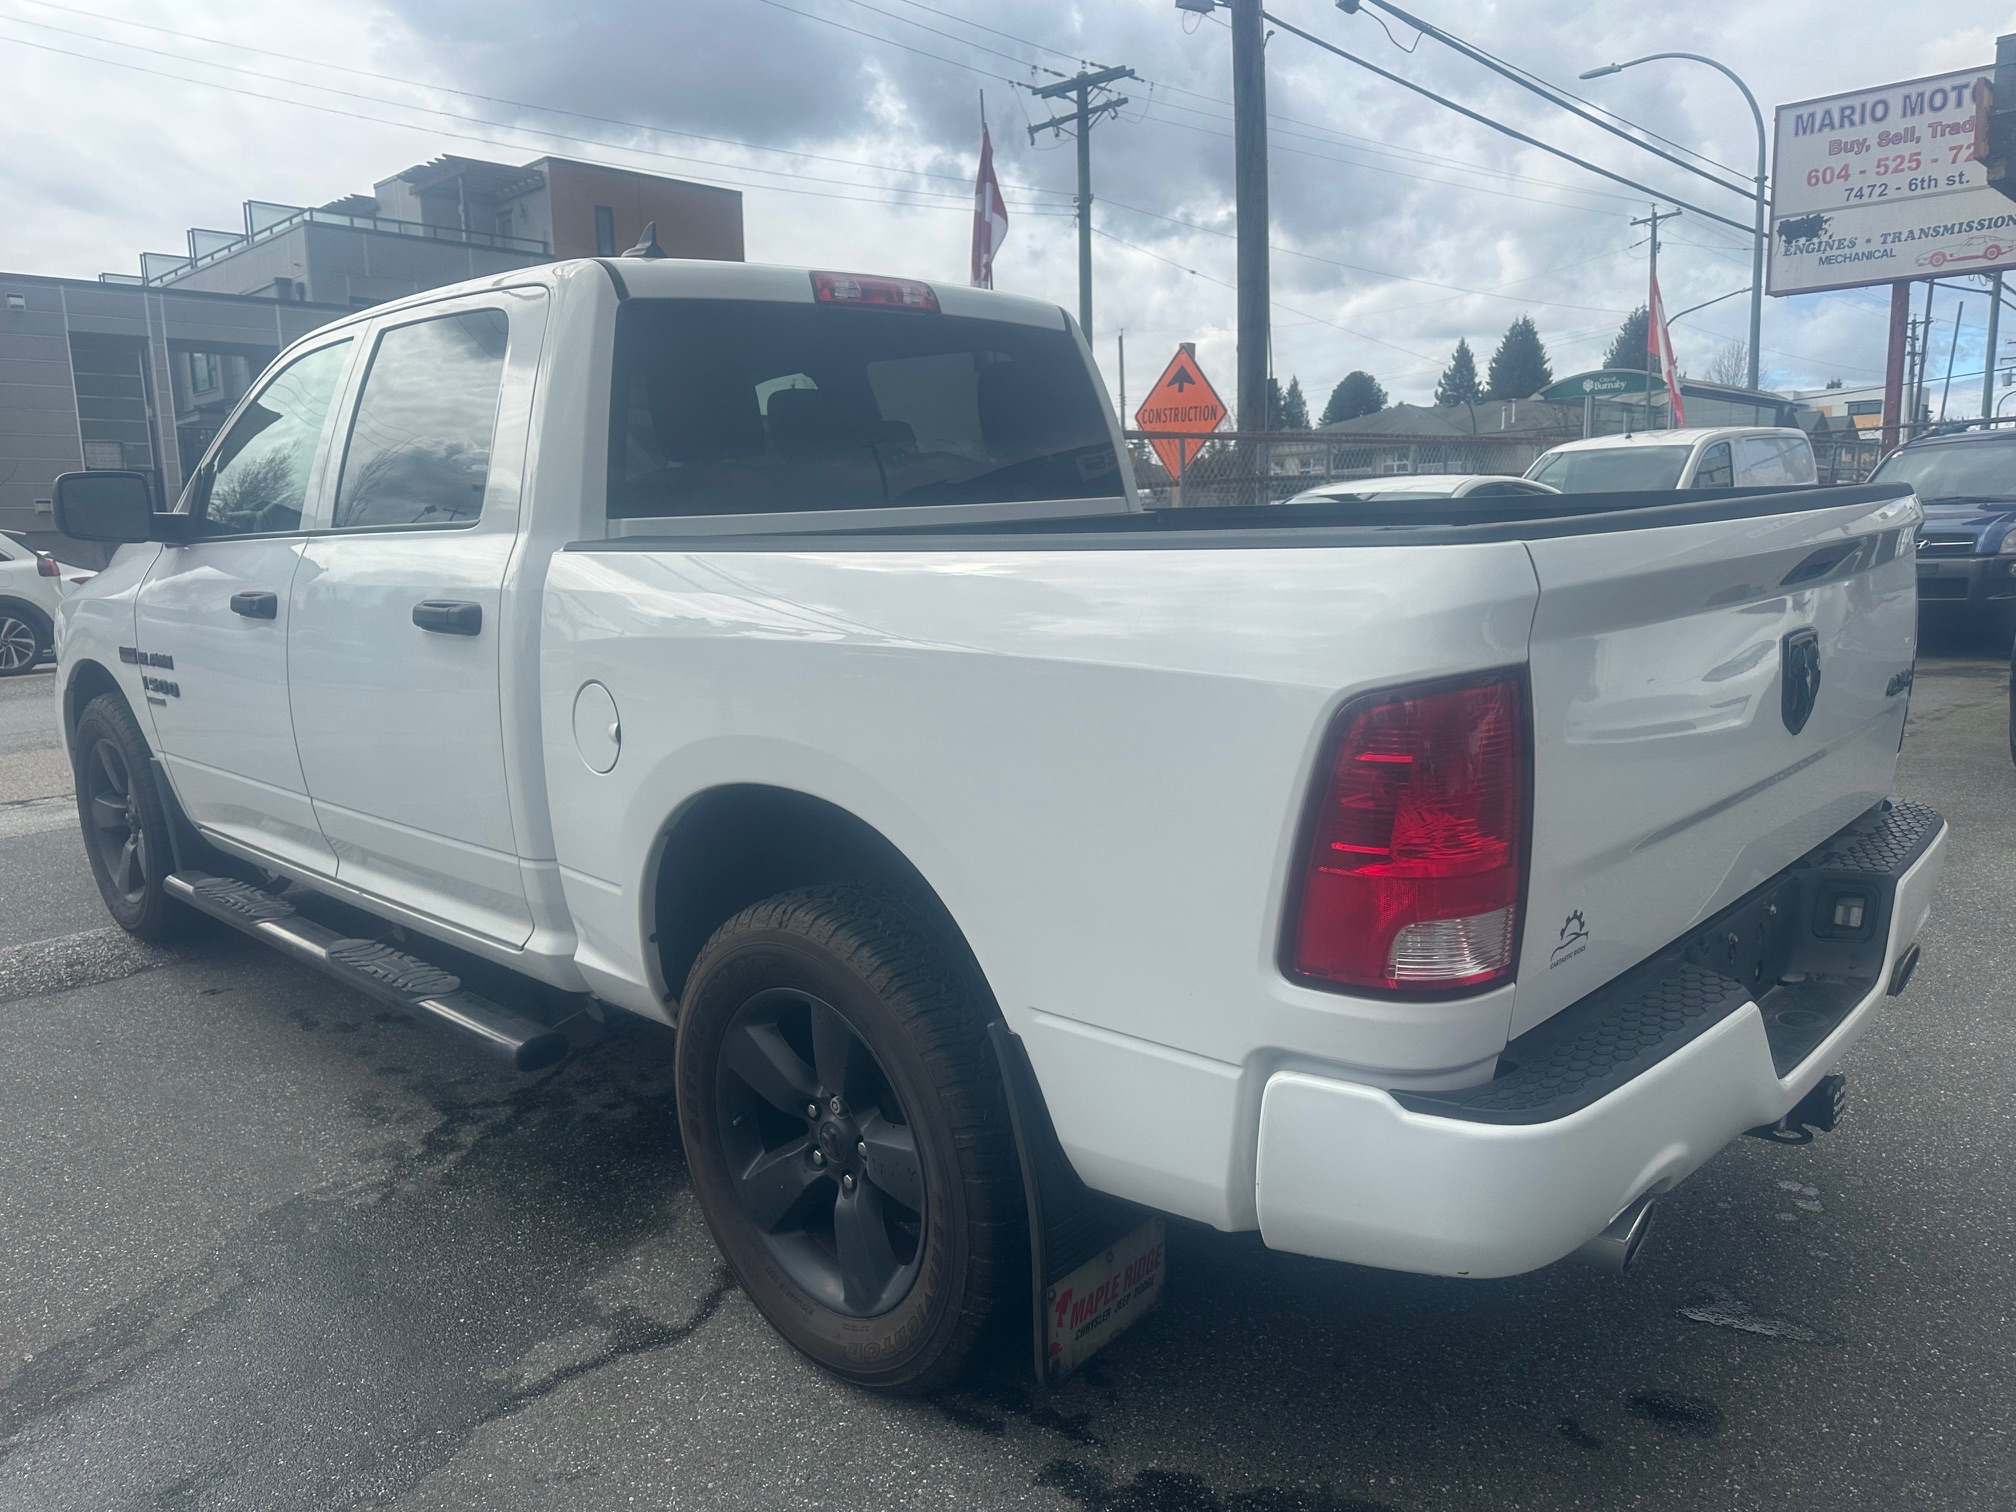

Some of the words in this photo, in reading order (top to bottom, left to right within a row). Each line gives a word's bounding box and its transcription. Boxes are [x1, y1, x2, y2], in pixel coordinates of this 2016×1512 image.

[1793, 98, 1890, 138] MARIO
[1828, 137, 1871, 156] Buy,
[1877, 125, 1922, 148] Sell,
[1806, 162, 1851, 187] 604
[1875, 151, 1922, 177] 525
[1844, 182, 1889, 202] 7472
[1907, 176, 1938, 193] 6th
[1945, 170, 1970, 186] st.
[1782, 236, 1858, 257] ENGINES
[1818, 247, 1897, 266] MECHANICAL
[1594, 379, 1627, 390] Burnaby
[1141, 405, 1218, 424] CONSTRUCTION
[142, 676, 181, 699] 1500
[1070, 1272, 1122, 1330] MAPLE
[1123, 1242, 1164, 1294] RIDGE
[1074, 1307, 1112, 1341] CHRYSLER
[1113, 1293, 1132, 1313] JEEP
